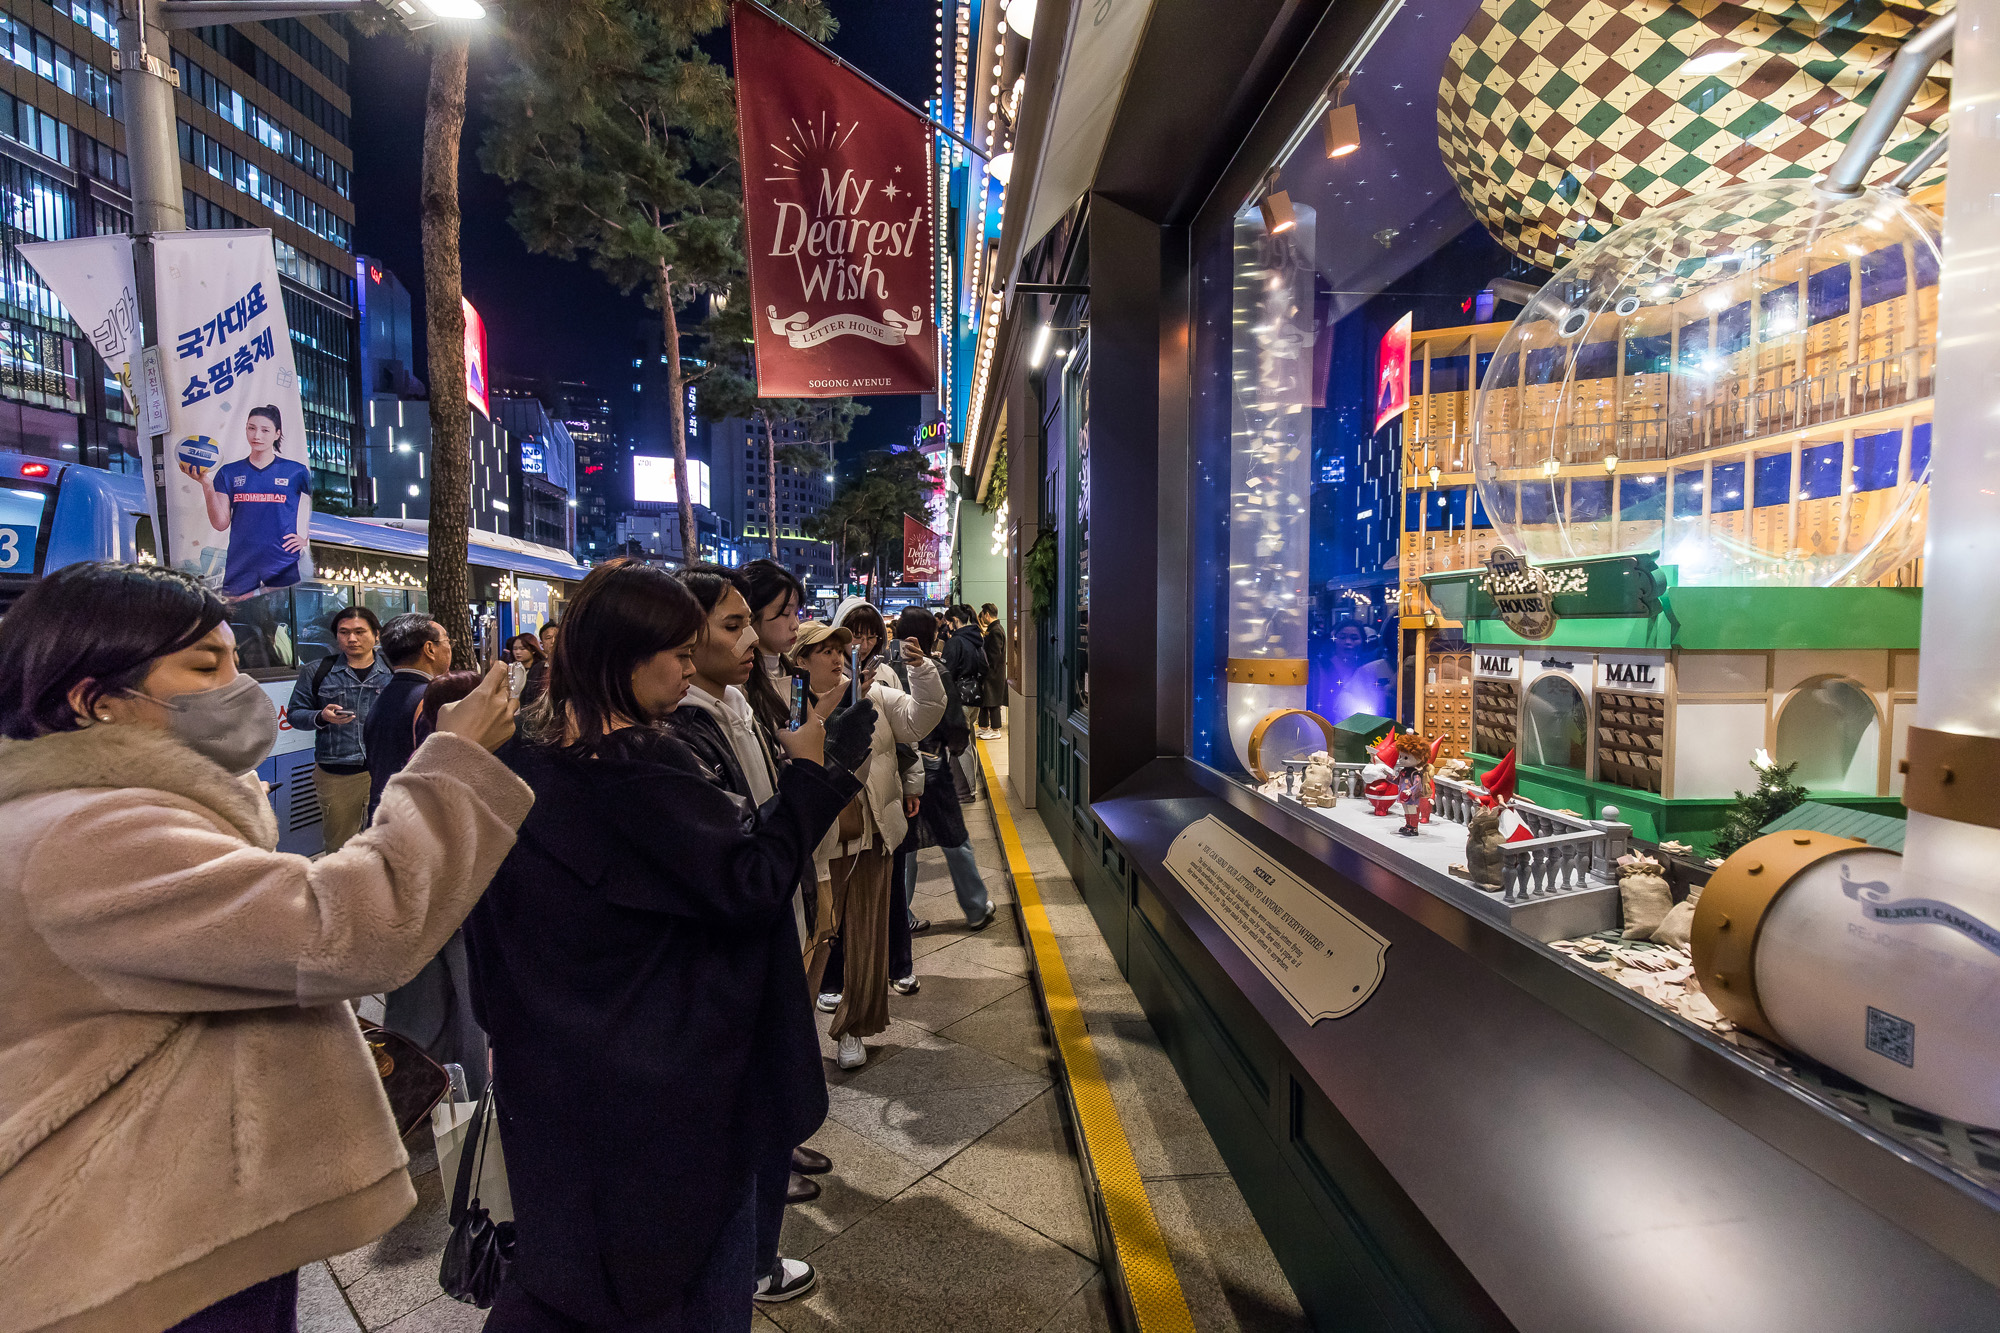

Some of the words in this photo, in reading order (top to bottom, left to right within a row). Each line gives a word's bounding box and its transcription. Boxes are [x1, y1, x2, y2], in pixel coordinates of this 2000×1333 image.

[816, 168, 873, 218] My
[768, 198, 922, 257] Dearest
[795, 252, 888, 302] Wish
[176, 281, 268, 359] 국가대표
[802, 320, 846, 343] LETTER
[849, 321, 885, 338] HOUSE
[181, 325, 275, 407] 쇼핑축제
[147, 367, 159, 396] 자전거
[808, 379, 849, 388] SOGONG
[852, 378, 892, 387] AVENUE
[152, 400, 163, 419] 주의
[907, 547, 937, 558] Dearest
[912, 556, 931, 566] Wish
[1493, 562, 1522, 578] THE
[1498, 599, 1546, 613] HOUSE
[1480, 655, 1513, 673] MAIL
[1605, 663, 1656, 683] MAIL
[1208, 850, 1219, 860] CAN
[1215, 856, 1228, 868] SEND
[1225, 864, 1238, 877] YOUR
[1234, 873, 1257, 893] LETTERS
[1253, 888, 1263, 898] TO
[1259, 895, 1284, 916] ANYONE!
[1253, 866, 1275, 886] SCENE.2
[1875, 907, 1930, 918] REJOICE
[1256, 936, 1268, 950] letters
[1279, 932, 1292, 947] letters
[1290, 943, 1303, 958] flying
